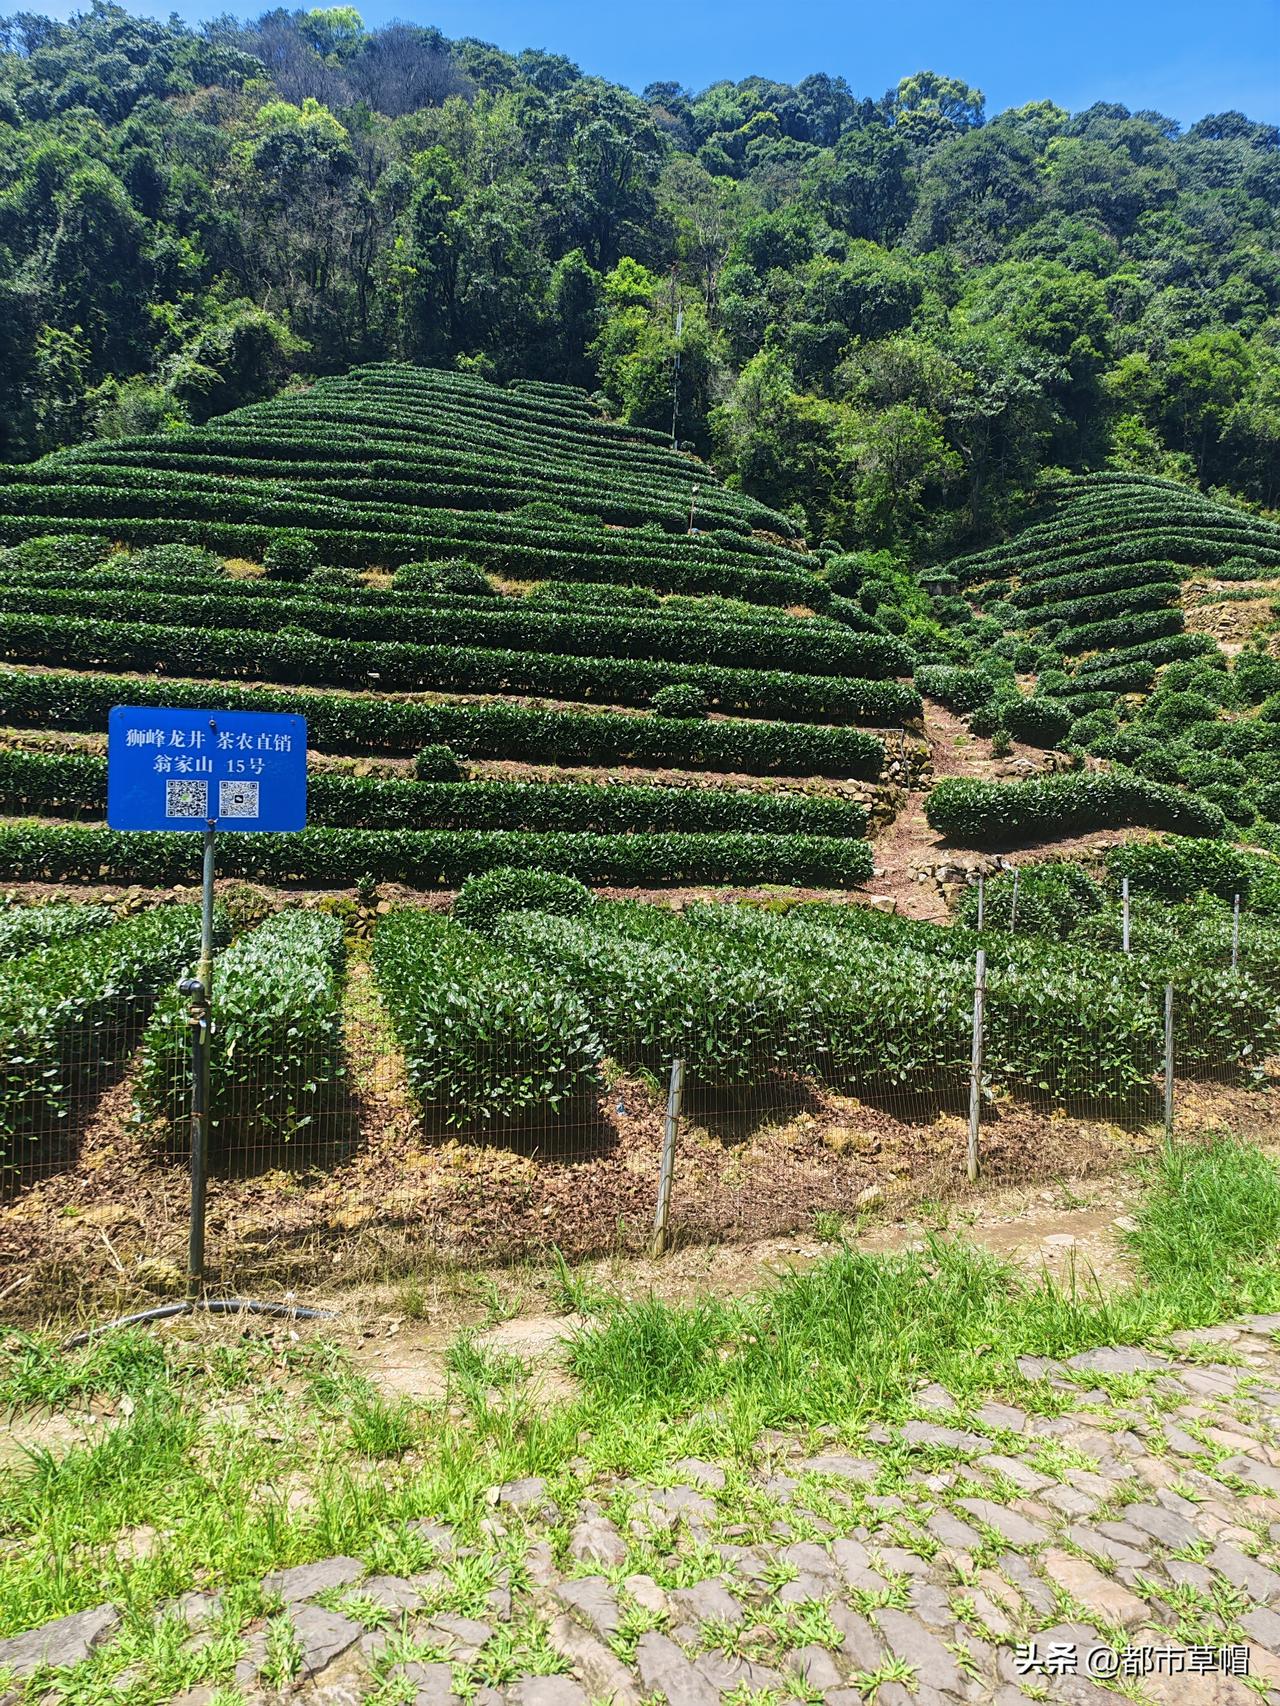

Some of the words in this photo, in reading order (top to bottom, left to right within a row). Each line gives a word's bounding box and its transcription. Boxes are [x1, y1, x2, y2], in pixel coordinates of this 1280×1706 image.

[125, 729, 206, 749] 狮峰龙井
[216, 731, 292, 752] 茶农直销
[152, 754, 213, 773] 翁家山
[226, 757, 266, 775] 15号
